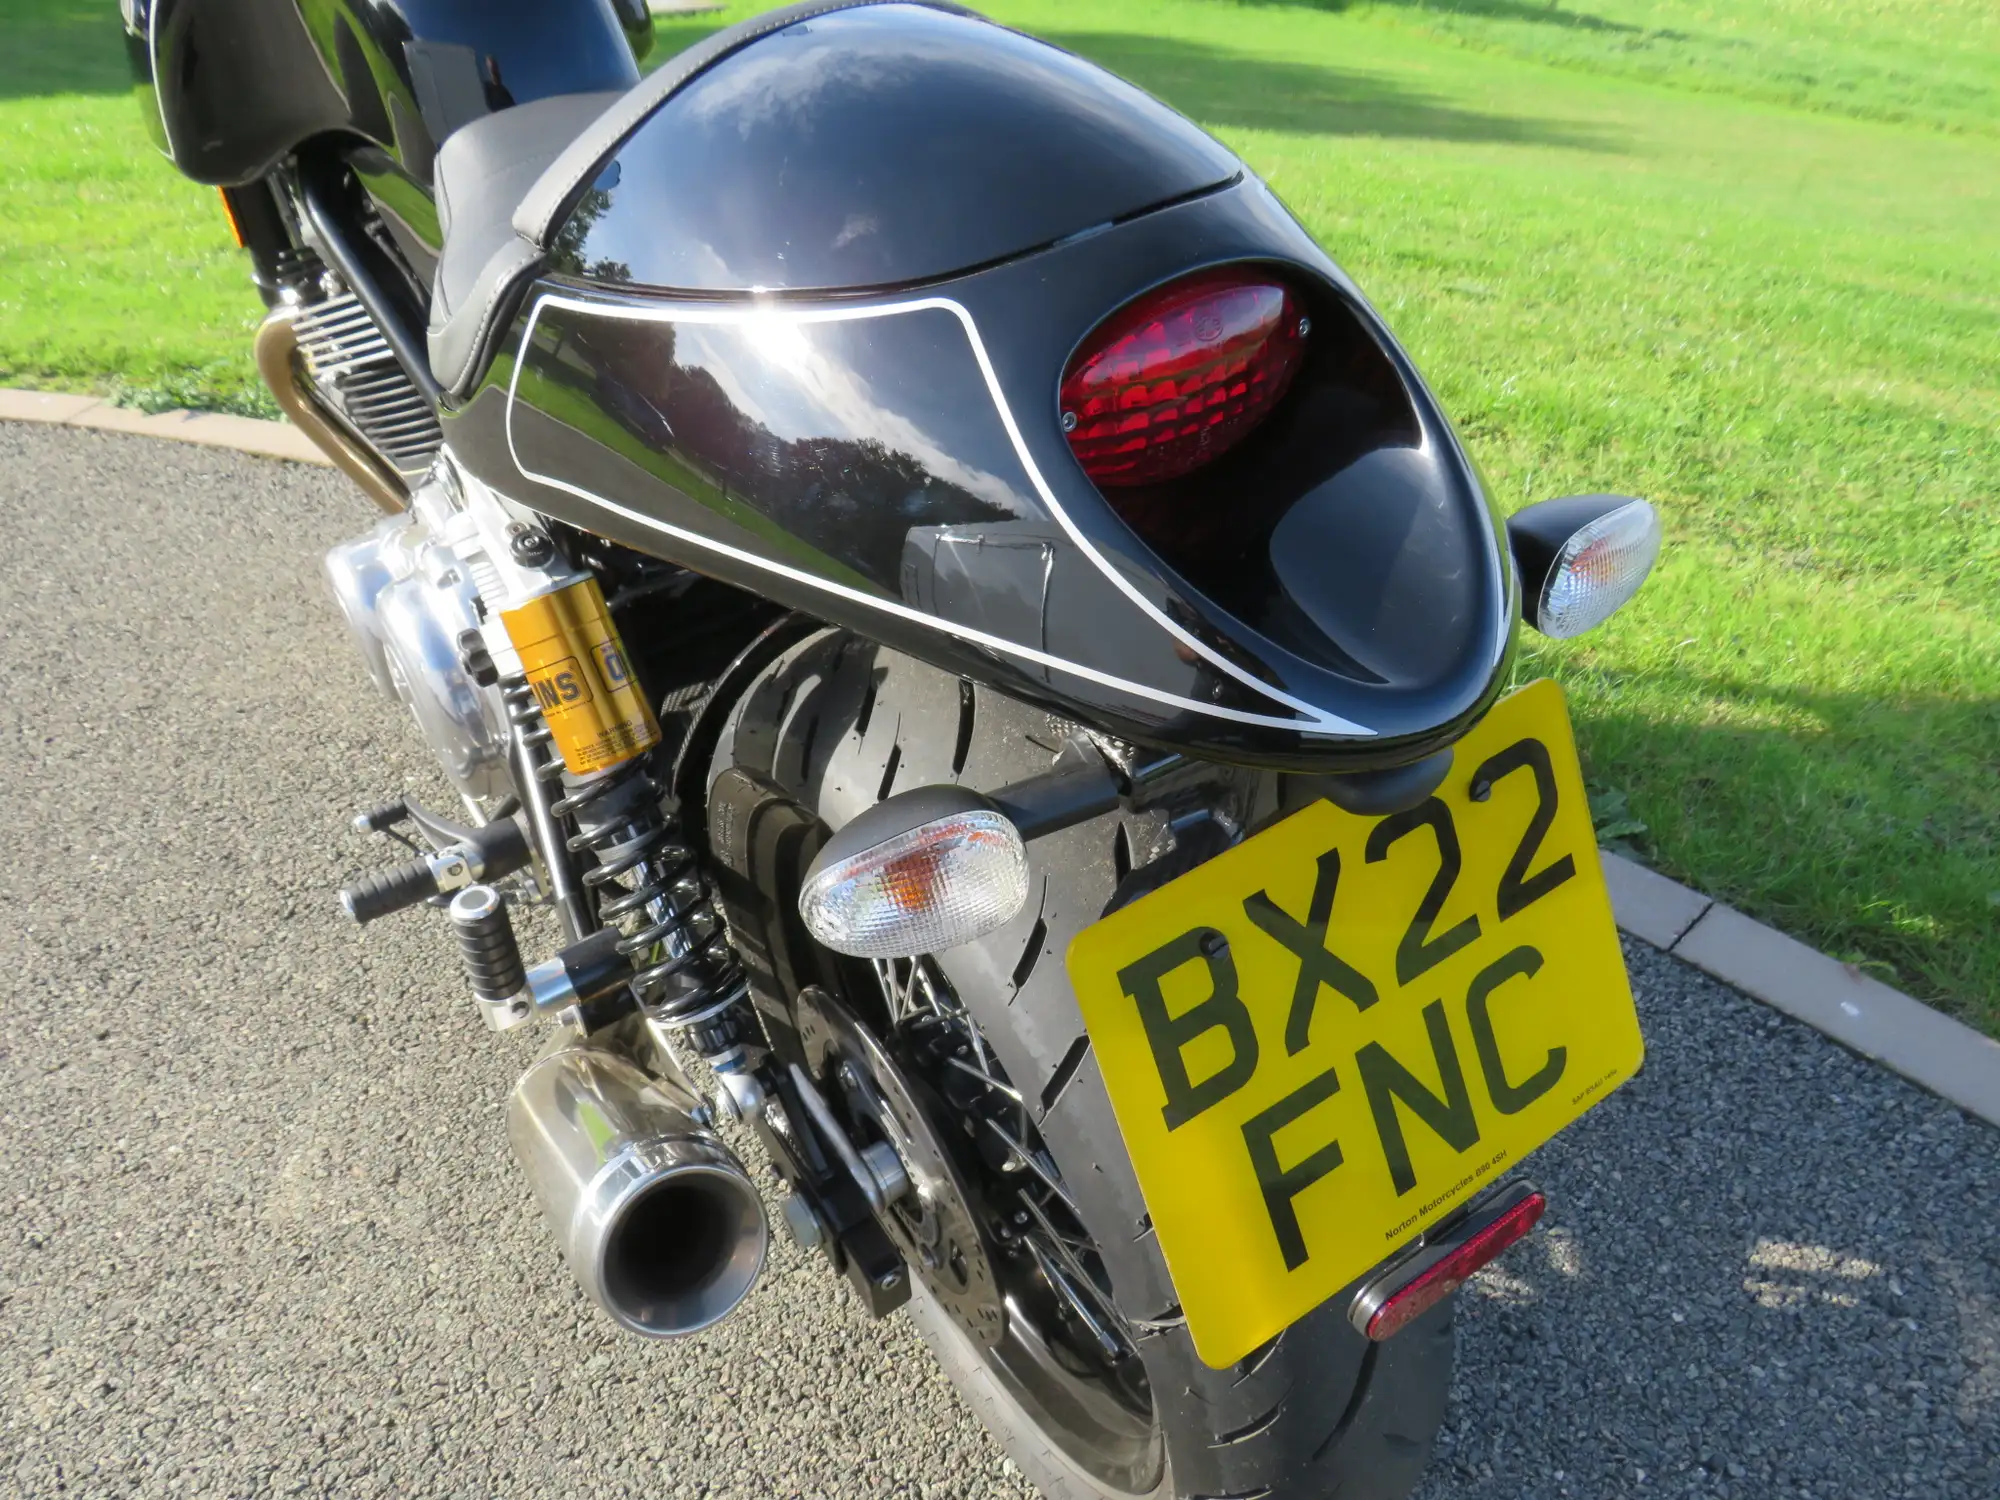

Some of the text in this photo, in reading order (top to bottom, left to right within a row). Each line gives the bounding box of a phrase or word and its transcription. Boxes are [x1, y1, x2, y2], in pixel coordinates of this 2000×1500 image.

[1117, 737, 1576, 1132] BX22
[1239, 945, 1567, 1273] FNC
[1385, 1214, 1418, 1241] Norton
[1418, 1173, 1474, 1216] Motorcycles
